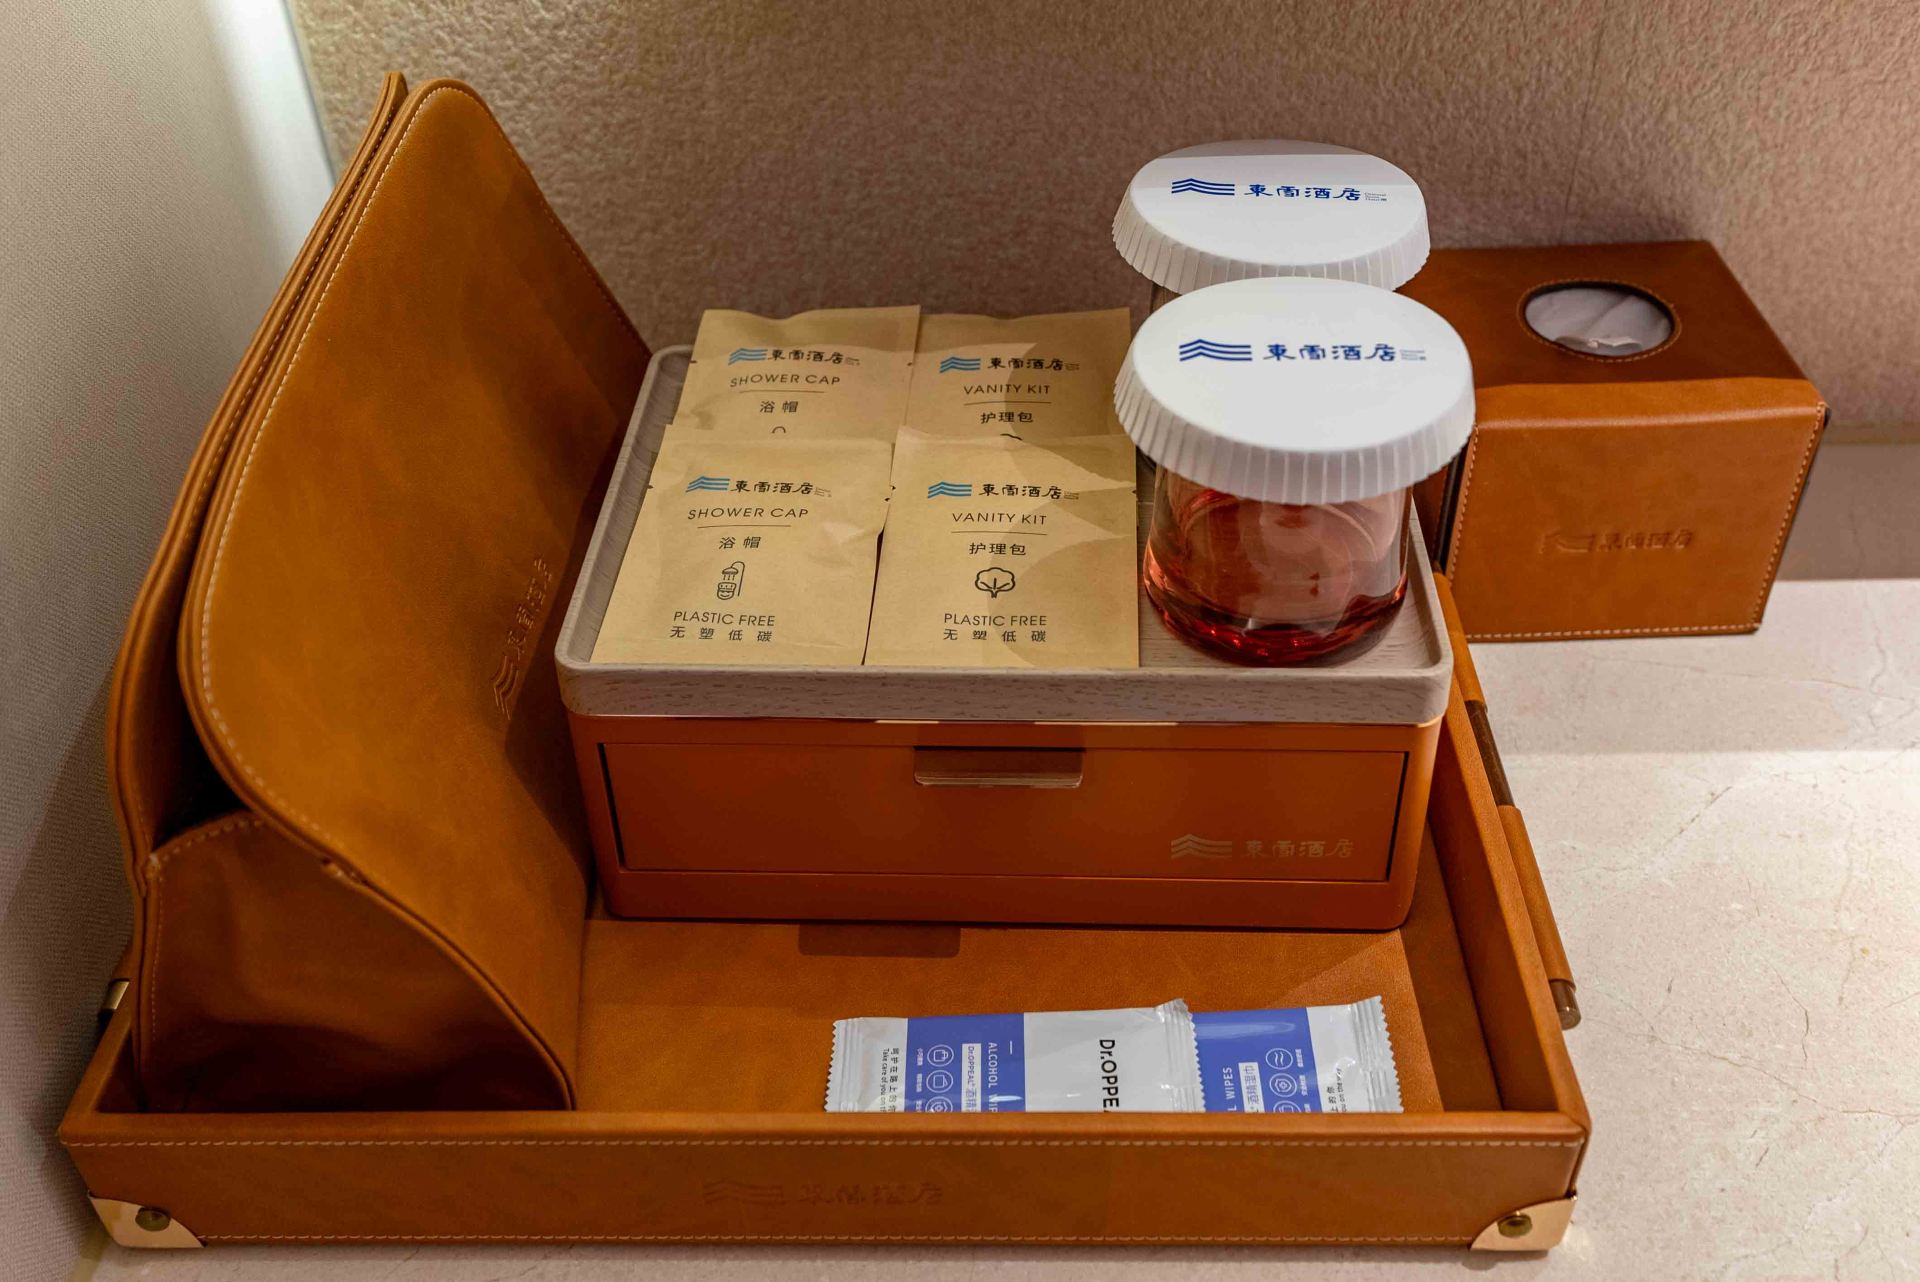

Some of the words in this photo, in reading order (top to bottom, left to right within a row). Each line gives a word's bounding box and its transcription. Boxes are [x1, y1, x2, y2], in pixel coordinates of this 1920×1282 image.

[730, 373, 800, 388] SHOWER
[805, 374, 841, 387] CAP
[963, 383, 1020, 395] VANITY
[1026, 384, 1051, 395] KIT
[759, 400, 799, 414] 浴帽
[980, 410, 1034, 424] 护理包
[687, 508, 765, 521] SHOWER
[770, 507, 810, 520] CAP
[952, 513, 1016, 523] VANITY
[1021, 514, 1047, 524] KIT
[718, 536, 762, 550] 浴帽
[968, 541, 1027, 556] 护理包
[673, 611, 735, 626] PLASTIC
[738, 614, 775, 627] FREE
[943, 612, 1006, 626] PLASTIC
[1009, 614, 1048, 626] FREE
[669, 626, 773, 643] 无塑低碳
[943, 628, 1047, 643] 无塑低碳
[881, 1048, 890, 1062] Take
[988, 1042, 998, 1088] ALCOHOL
[1099, 1039, 1120, 1112] Dr.OPPE
[1223, 1067, 1236, 1099] WIPES
[965, 1088, 977, 1112] 酒精
